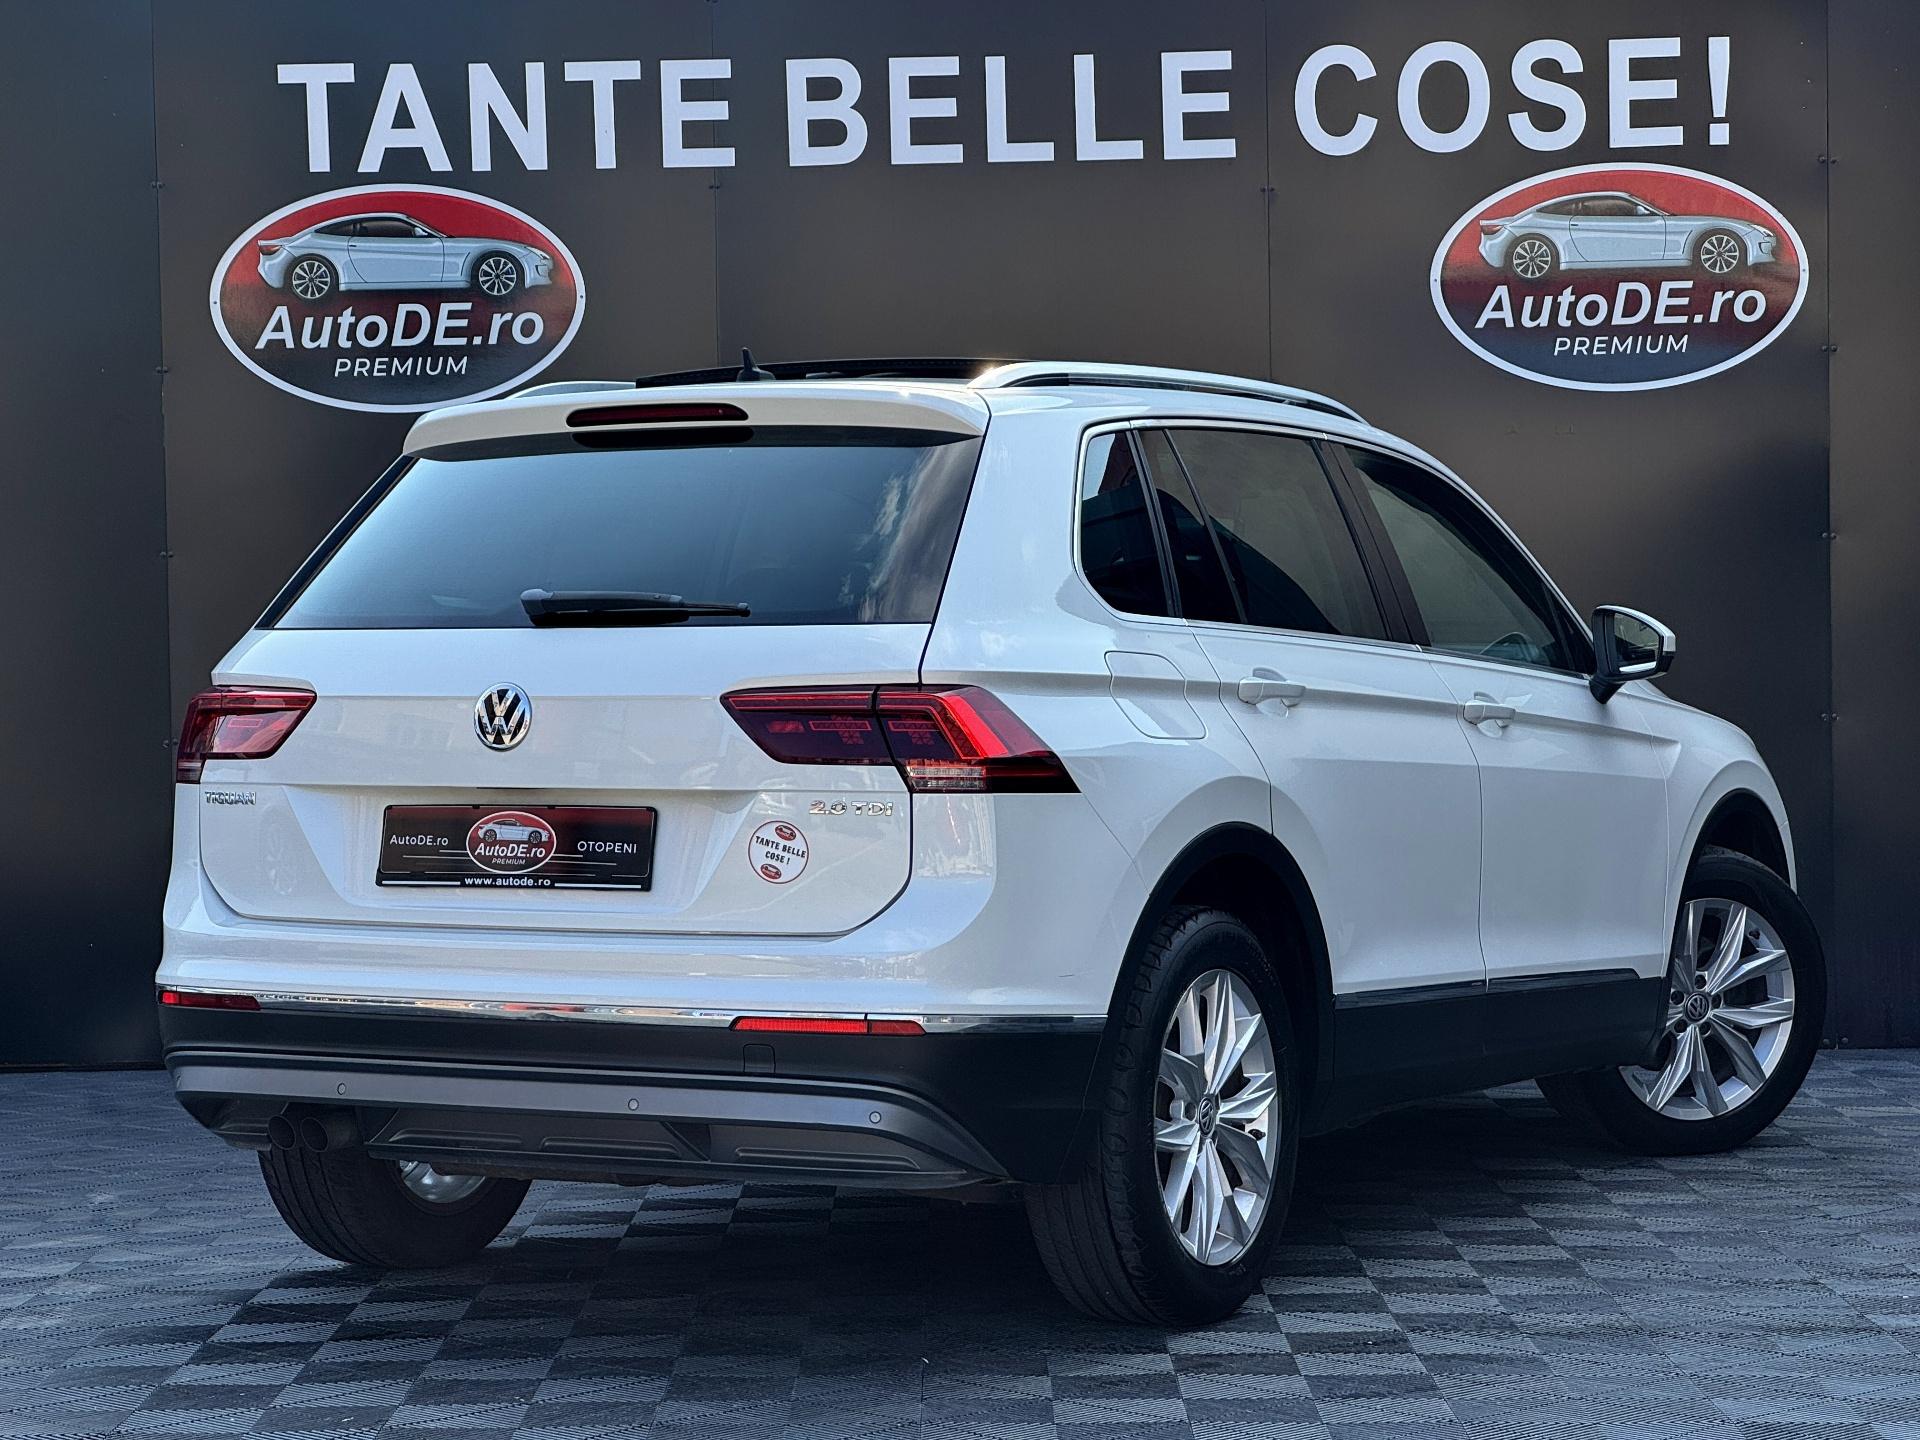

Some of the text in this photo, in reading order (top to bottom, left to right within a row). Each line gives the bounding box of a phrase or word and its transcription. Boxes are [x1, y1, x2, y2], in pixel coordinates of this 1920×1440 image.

[277, 36, 1731, 173] TANTE BELLE COSE!
[1475, 280, 1767, 329] AutoDE.ro
[255, 302, 545, 350] AutoDE.ro
[1553, 333, 1690, 357] PREMIUM
[333, 355, 469, 378] PREMIUM
[204, 791, 256, 805] TIGUAN
[809, 800, 893, 816] 2.0 TDI
[389, 835, 448, 847] AutoDE.ro
[577, 840, 637, 854] OTOPENI
[755, 836, 806, 858] TANTE BELLE
[475, 842, 545, 858] AutoDE.ro
[765, 850, 785, 863] COSE
[491, 857, 525, 865] PREMIUM
[464, 876, 551, 887] www.autode.ro
